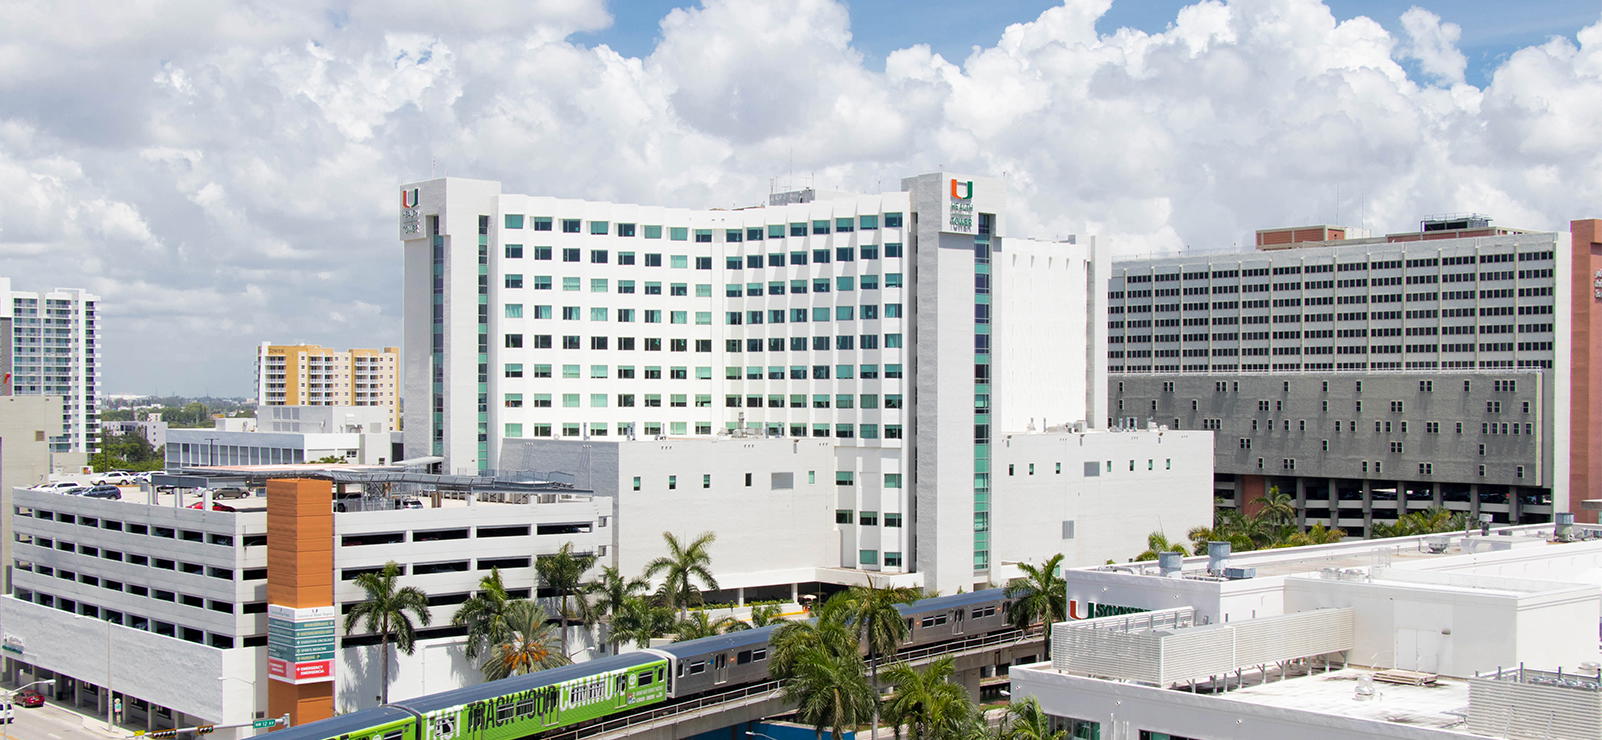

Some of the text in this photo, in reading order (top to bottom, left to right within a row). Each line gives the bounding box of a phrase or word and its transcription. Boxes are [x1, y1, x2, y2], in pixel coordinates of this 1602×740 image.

[402, 188, 419, 208] U
[951, 179, 973, 199] U
[466, 693, 515, 733] TRACK
